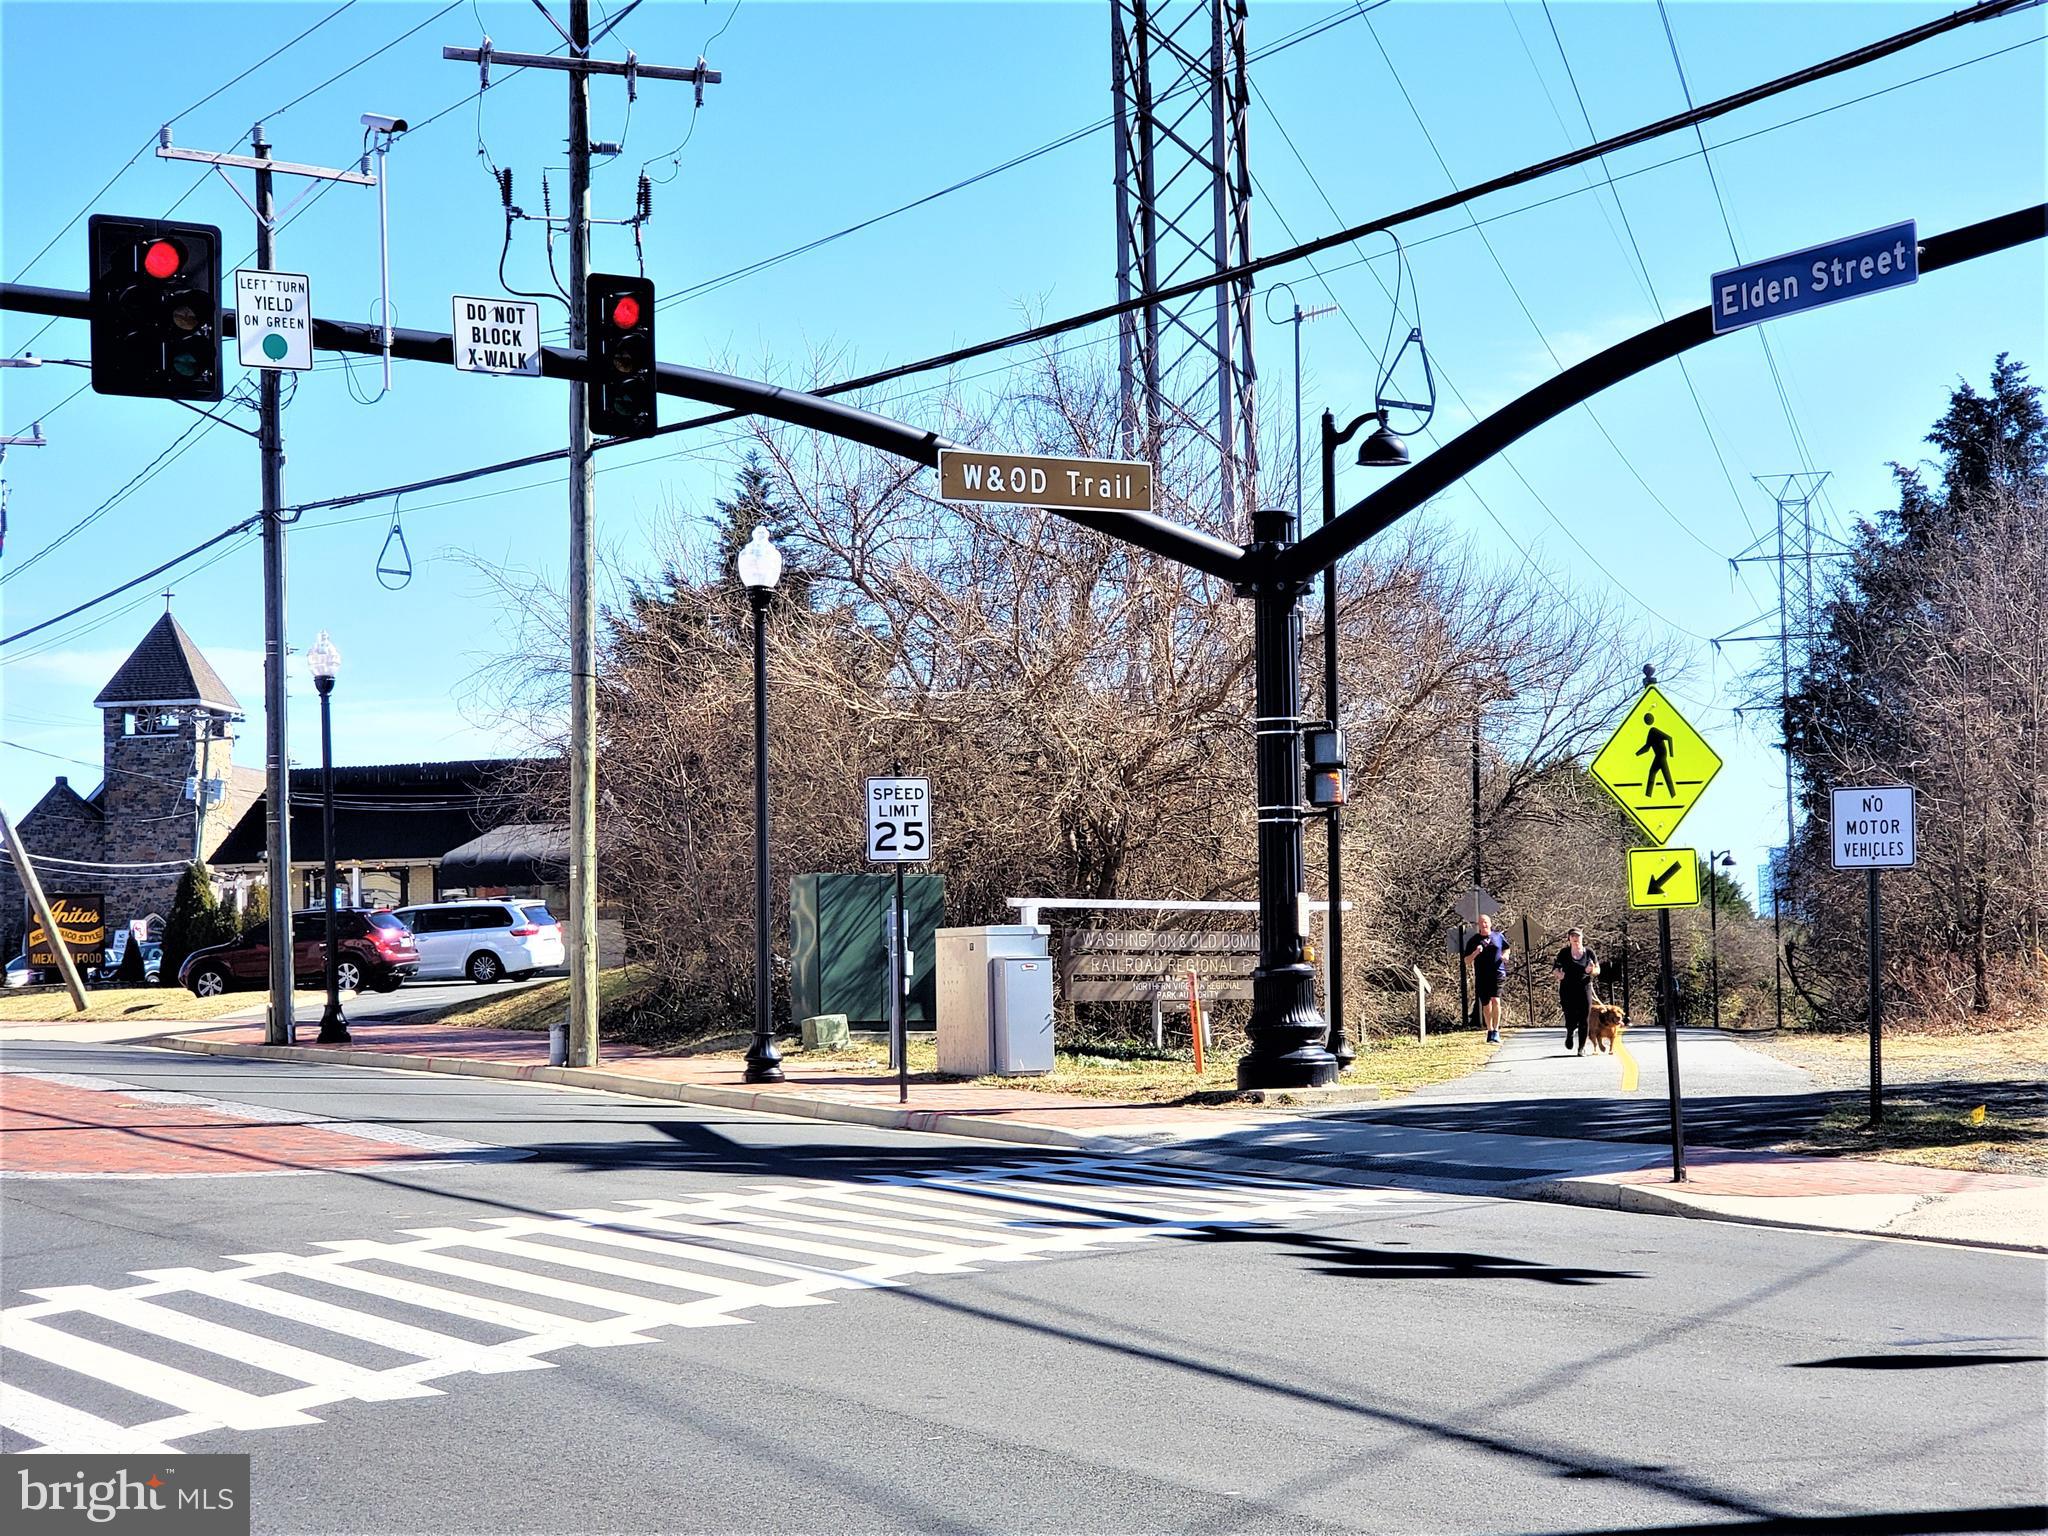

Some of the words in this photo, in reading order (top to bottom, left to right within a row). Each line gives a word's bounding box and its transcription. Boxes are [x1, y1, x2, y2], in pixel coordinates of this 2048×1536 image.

[240, 277, 266, 291] LEFT
[277, 281, 305, 293] TURN
[1721, 275, 1798, 316] Elden
[1811, 240, 1906, 292] Street
[254, 295, 293, 312] YIELD
[244, 314, 259, 326] ON
[266, 316, 304, 329] GREEN
[466, 303, 487, 322] DO
[494, 306, 526, 325] NOT
[471, 326, 522, 347] BLOCK
[468, 348, 528, 370] X-WALK
[962, 463, 1047, 494] W&OD
[1066, 470, 1131, 500] Trail
[873, 787, 924, 801] SPEED
[879, 804, 919, 817] LIMIT
[1863, 797, 1883, 813] NO
[1846, 819, 1900, 835] MOTOR
[874, 821, 925, 851] 25
[1844, 841, 1904, 858] VEHICLES
[78, 932, 102, 941] STYLE
[1083, 932, 1176, 948] WASHINGTON
[1190, 933, 1217, 948] OLD
[1222, 934, 1260, 948] DOMIN
[32, 953, 74, 964] MEXI
[77, 953, 102, 964] FOOD
[1091, 957, 1163, 973] RAILROAD
[1168, 958, 1237, 973] REGIONAL
[1133, 981, 1171, 990] NORTHERN
[1156, 991, 1177, 999] PARK
[1179, 991, 1219, 999] AUORITY
